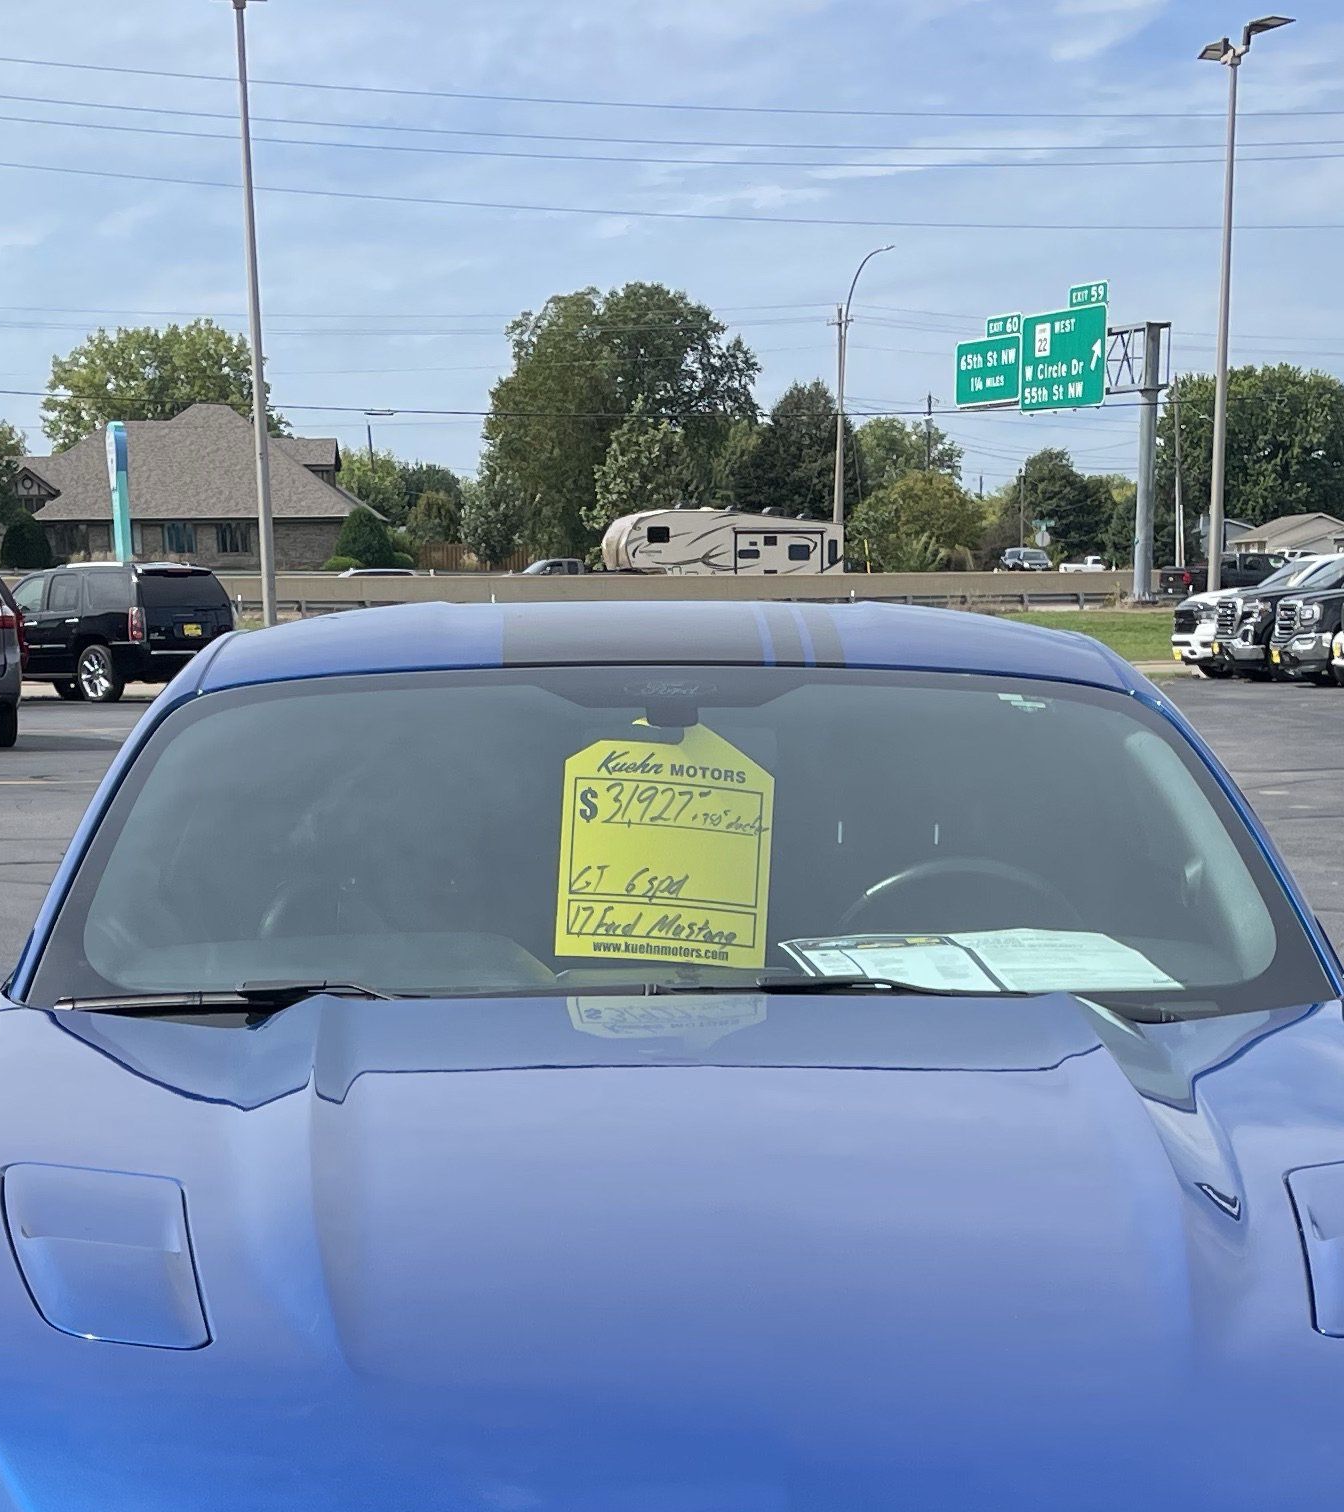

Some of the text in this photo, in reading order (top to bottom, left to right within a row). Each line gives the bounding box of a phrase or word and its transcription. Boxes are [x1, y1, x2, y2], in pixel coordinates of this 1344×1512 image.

[1072, 285, 1104, 303] EXIT 59
[989, 317, 1019, 333] EXIT 60
[1054, 318, 1076, 333] WEST
[1037, 338, 1048, 353] 22
[960, 348, 1016, 371] 65th St NW
[1024, 358, 1084, 382] W Circle Dr
[985, 374, 1005, 388] MILES
[1024, 381, 1083, 405] 55th St NW
[597, 750, 747, 784] Kuehn MOTORS
[646, 912, 738, 949] Mustang
[592, 941, 729, 962] www.kuehnmotors.com
